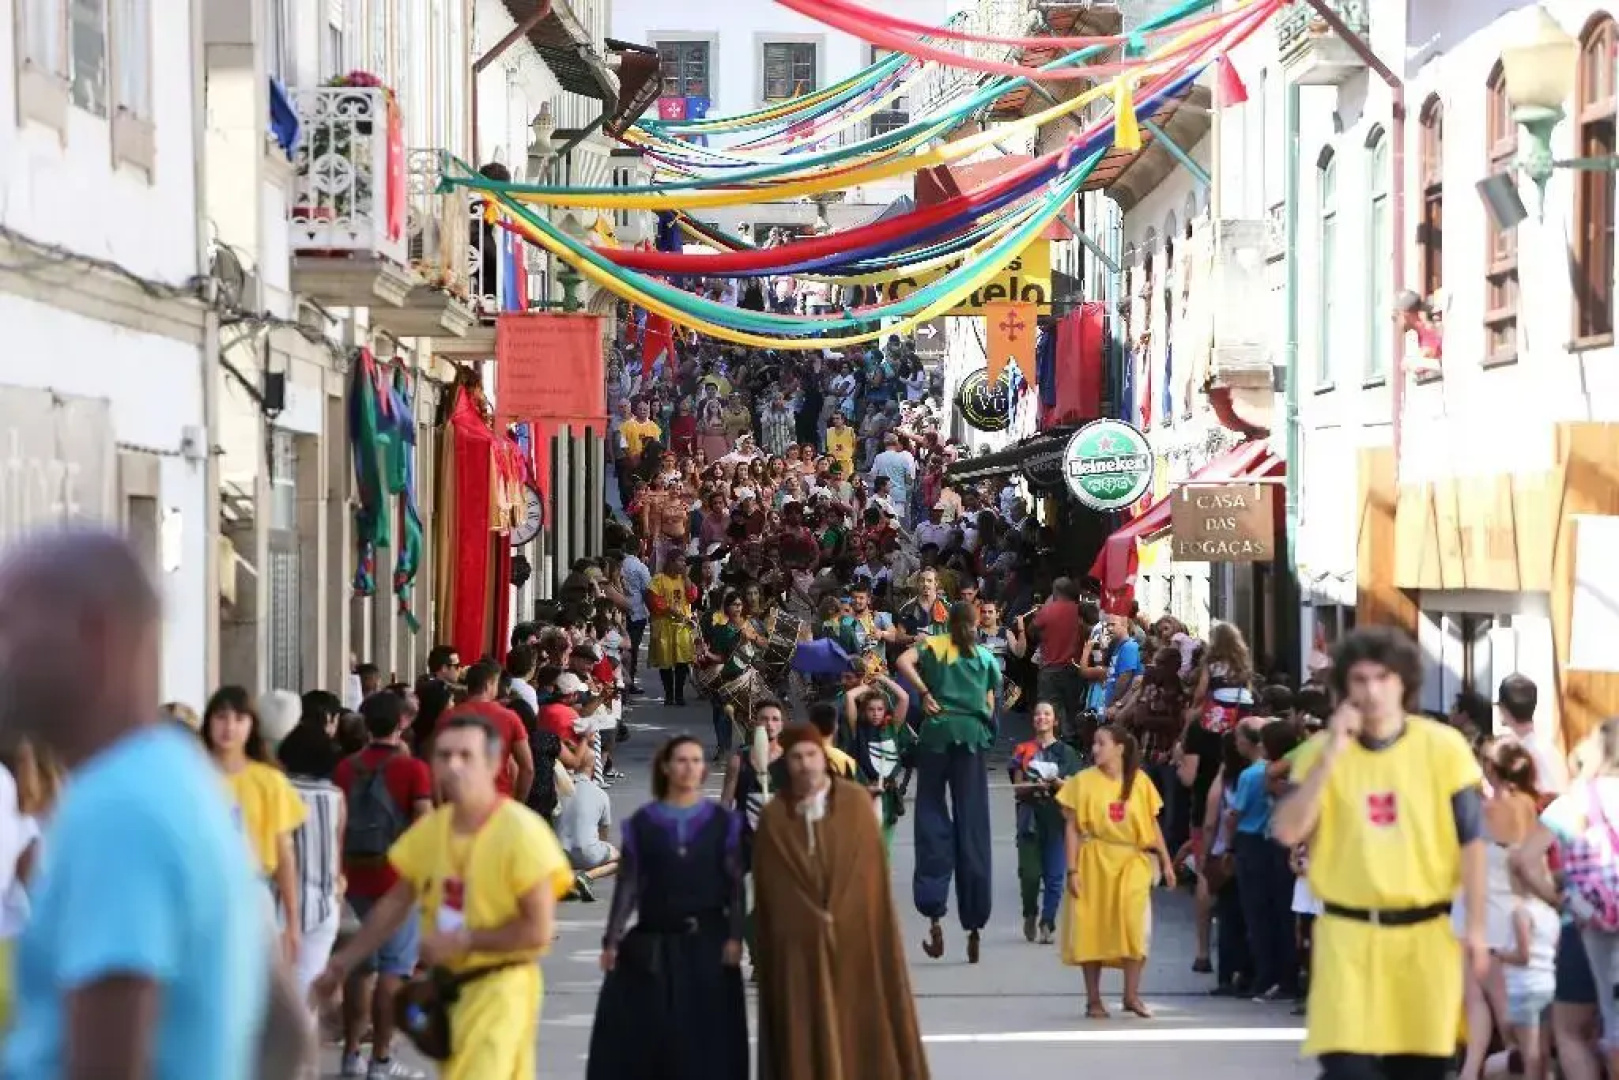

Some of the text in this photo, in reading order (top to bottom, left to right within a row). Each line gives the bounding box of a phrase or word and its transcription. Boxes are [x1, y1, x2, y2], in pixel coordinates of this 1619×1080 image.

[888, 276, 1046, 308] Ctelo
[1071, 455, 1145, 475] Heineken
[1196, 494, 1245, 509] CASA
[1205, 517, 1236, 531] DAS
